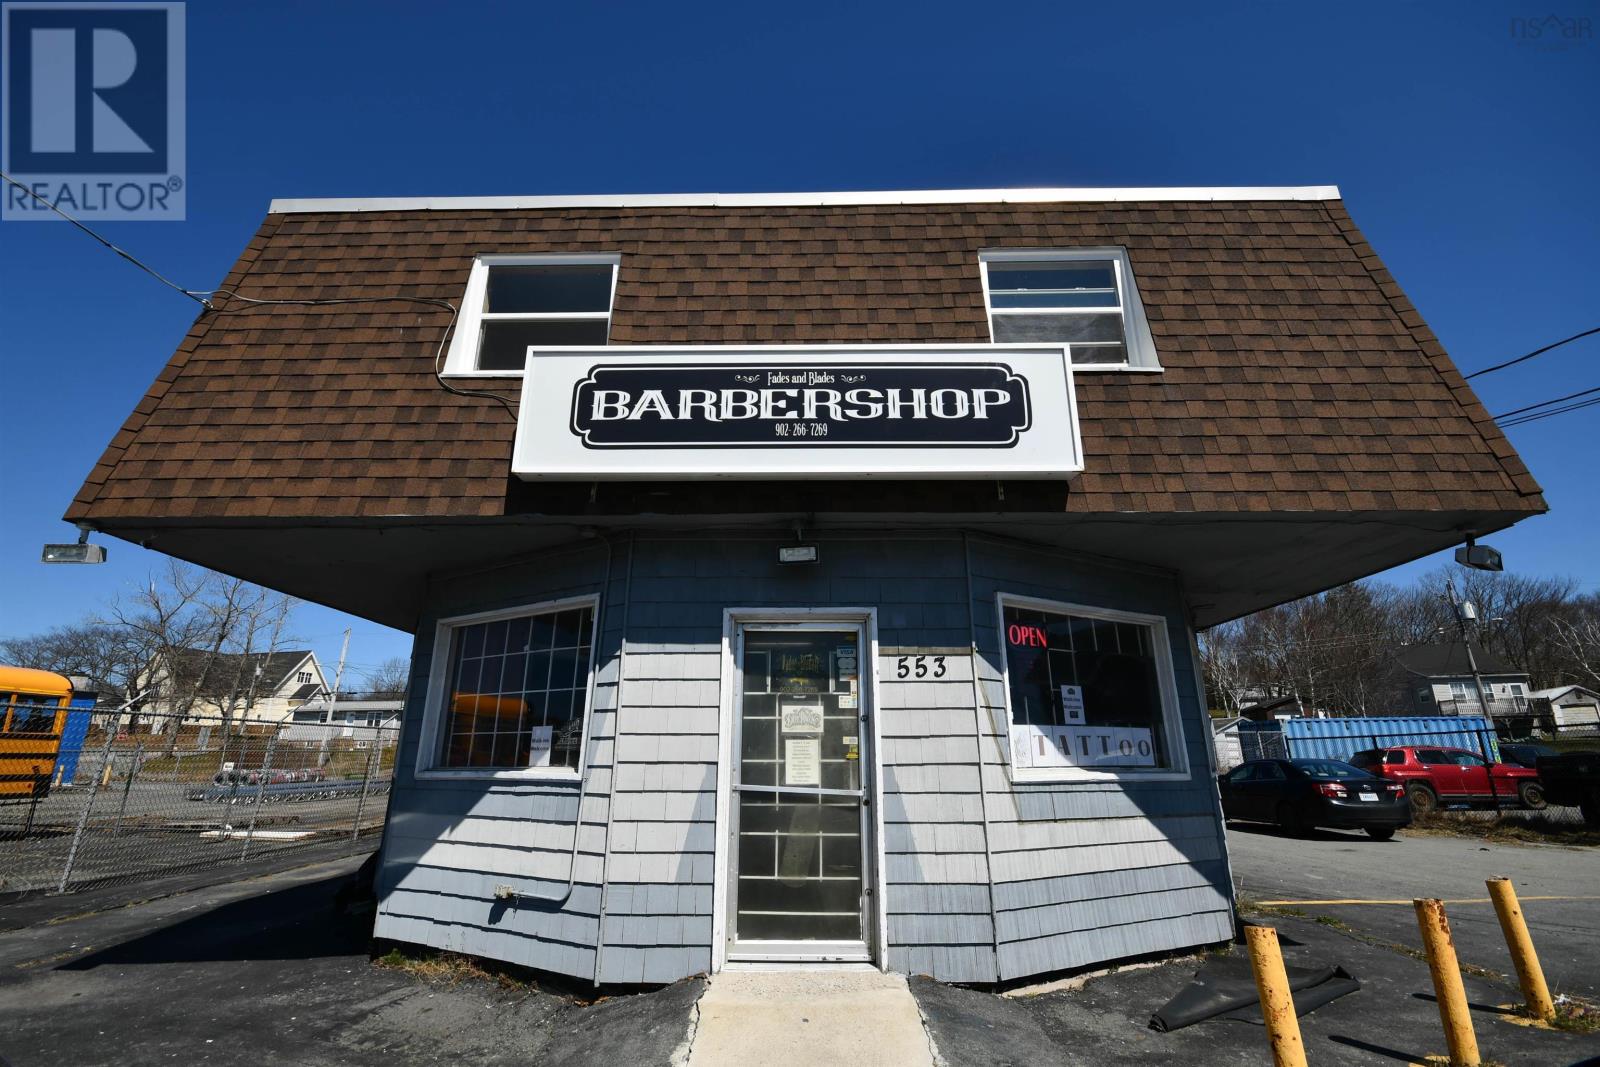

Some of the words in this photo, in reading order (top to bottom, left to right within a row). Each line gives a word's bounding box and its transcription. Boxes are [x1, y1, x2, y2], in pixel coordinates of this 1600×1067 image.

[767, 371, 790, 386] Fades
[791, 371, 807, 384] and
[808, 371, 835, 386] Blades
[590, 388, 1011, 422] BARBERSHOP
[1008, 624, 1047, 648] OPEN
[897, 655, 947, 679] 553
